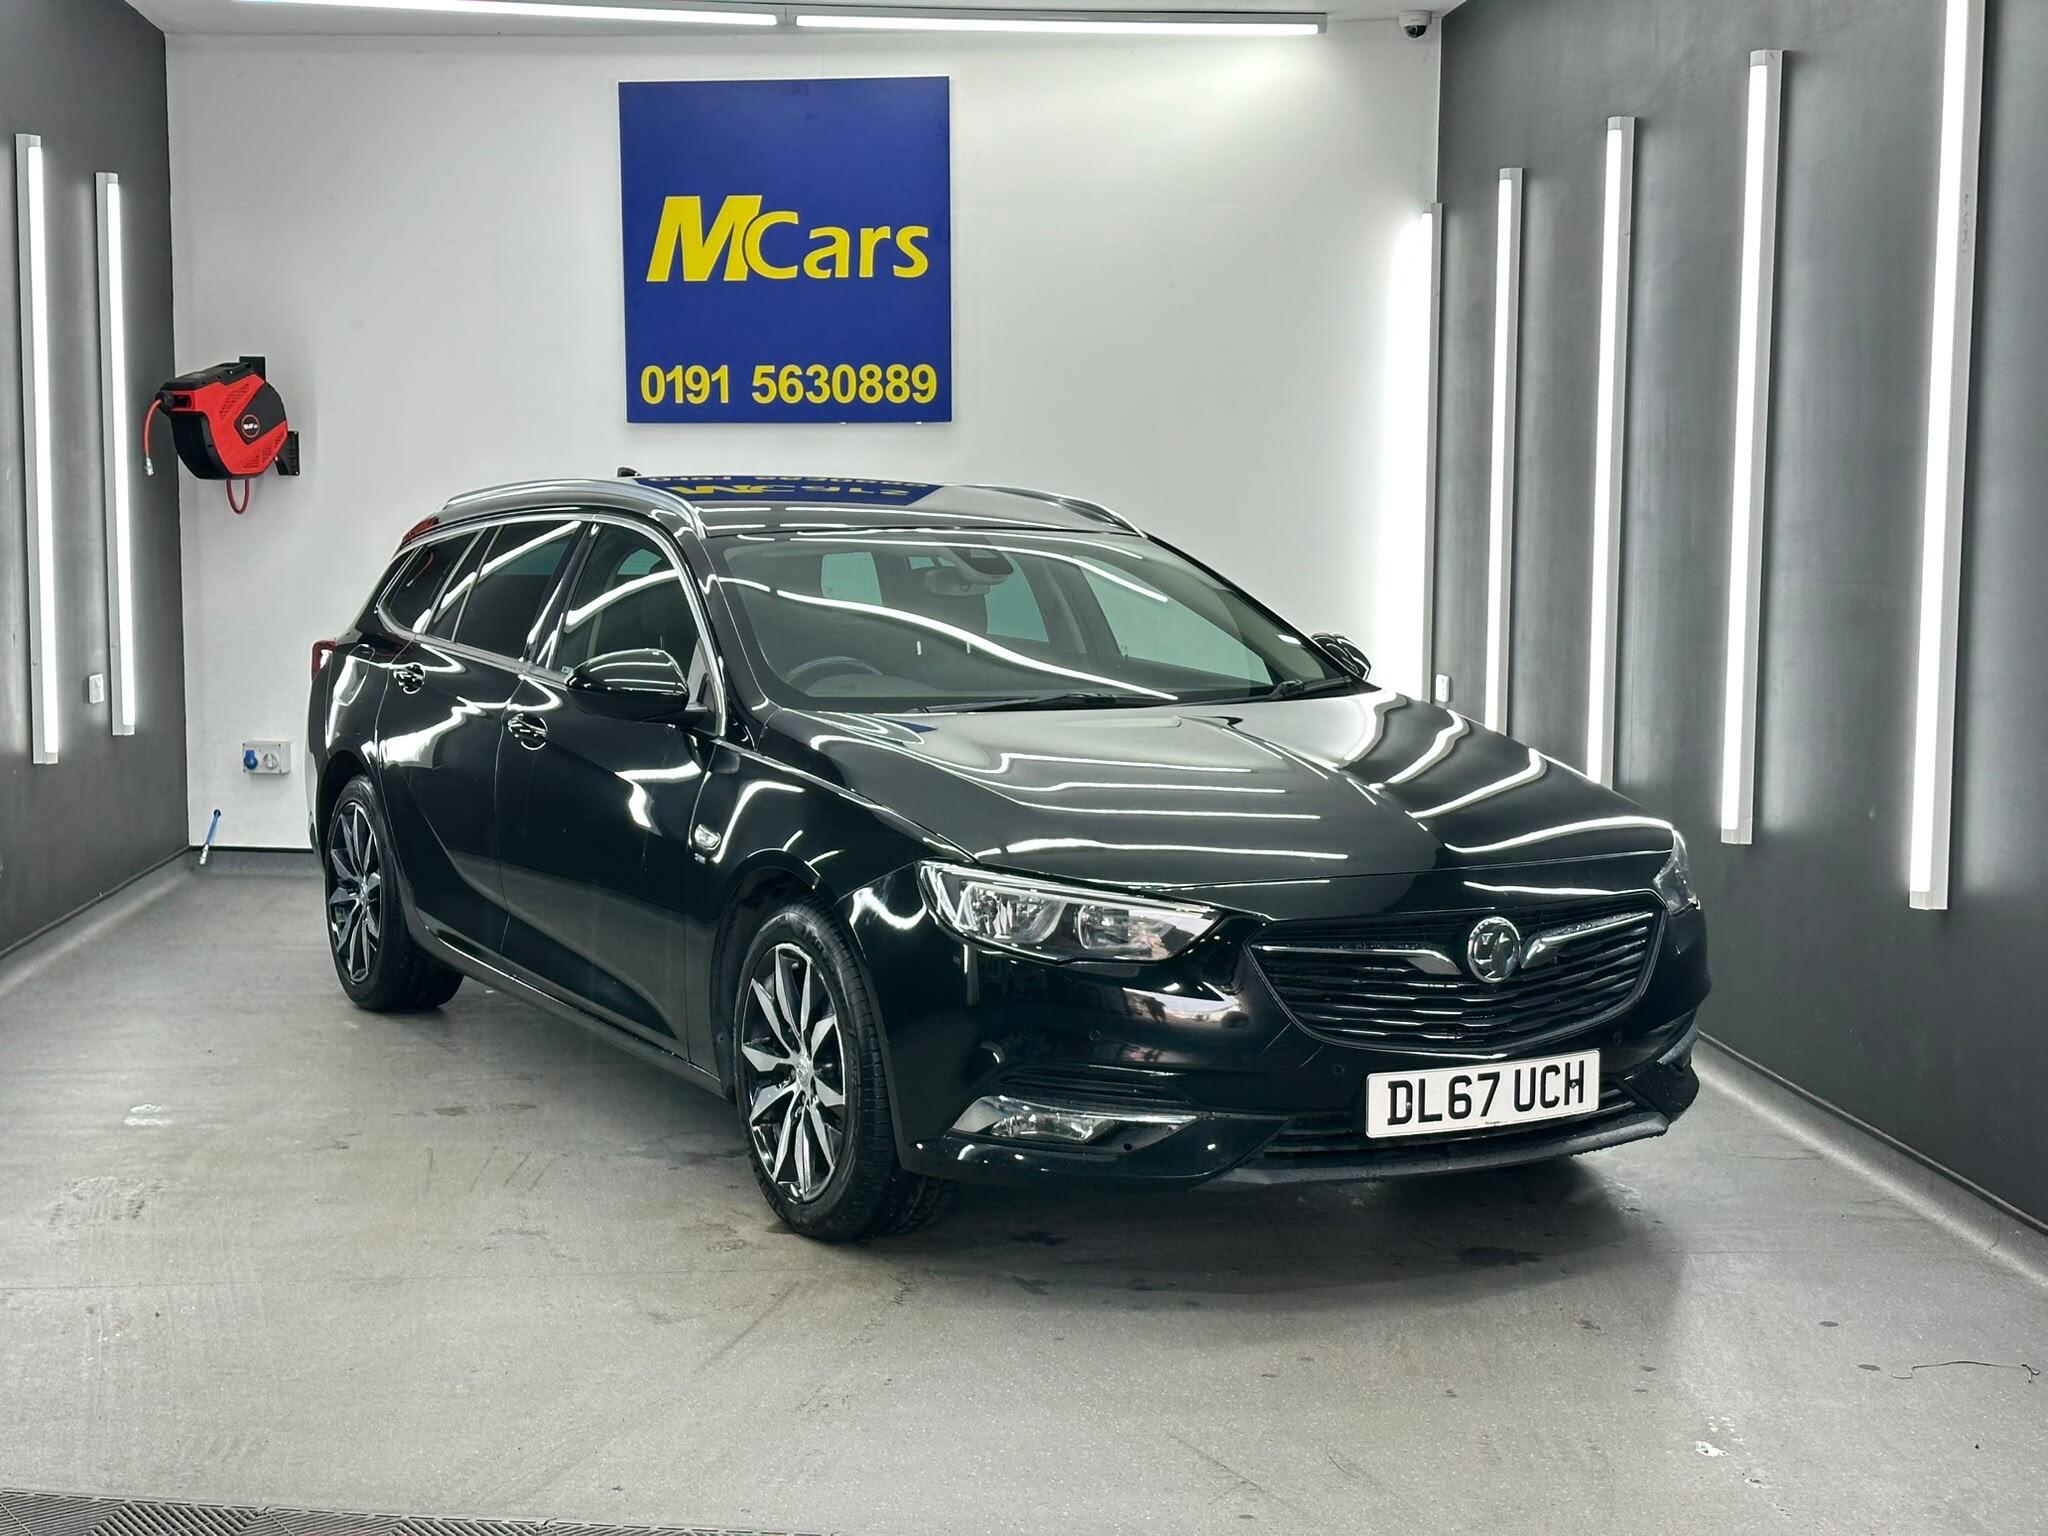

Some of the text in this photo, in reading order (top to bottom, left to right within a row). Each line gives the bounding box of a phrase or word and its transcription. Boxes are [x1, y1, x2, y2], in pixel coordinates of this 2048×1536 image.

[646, 195, 929, 282] MCars
[641, 364, 937, 404] 0191 5630889
[1387, 1060, 1585, 1126] DL67 UCH
